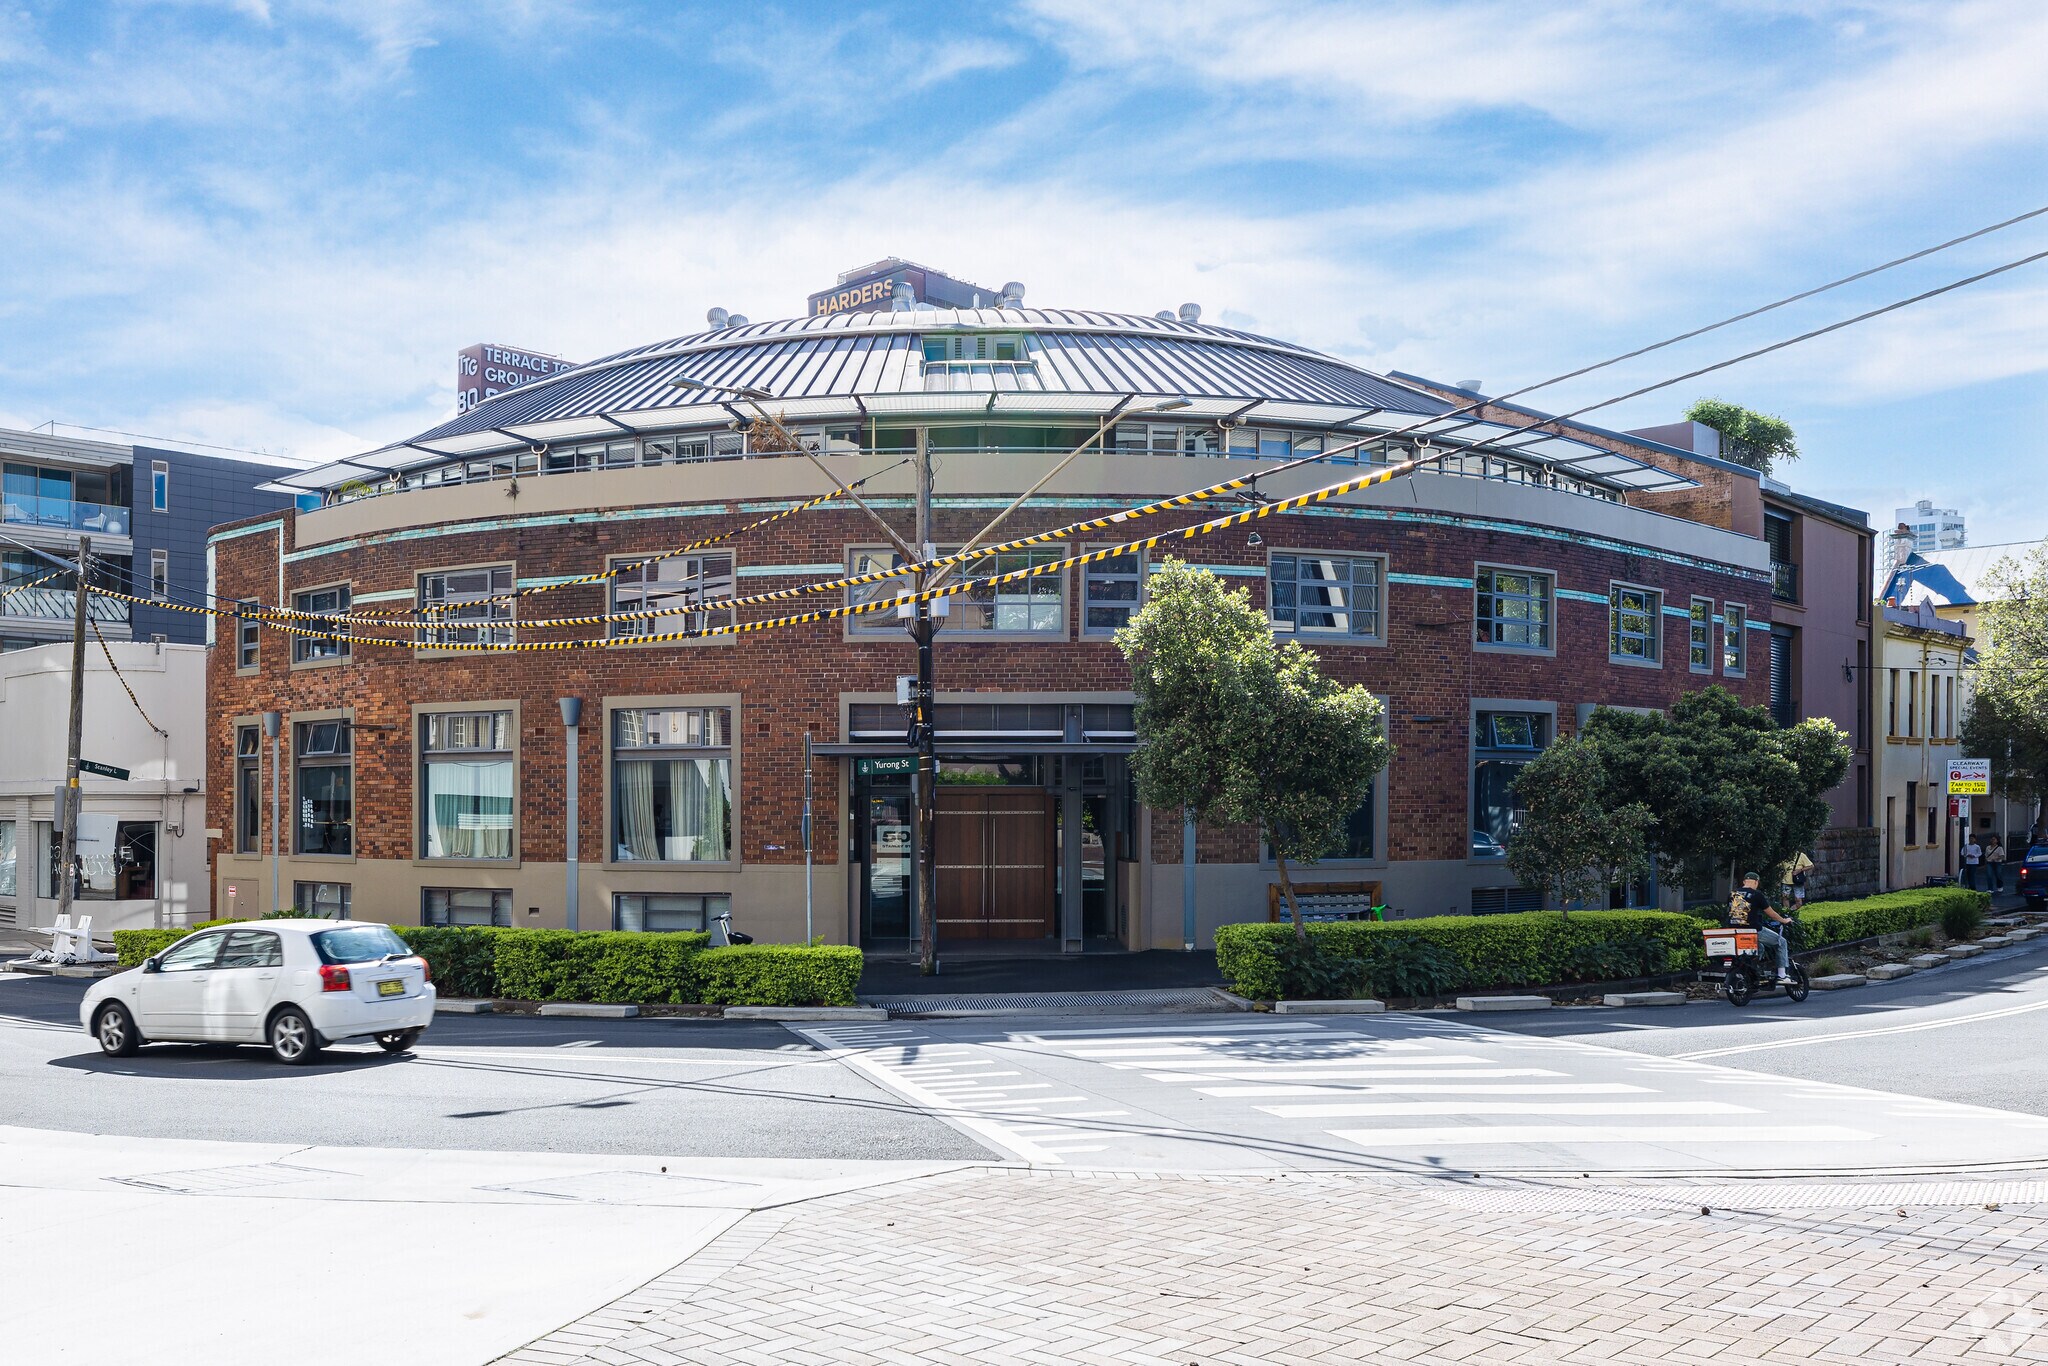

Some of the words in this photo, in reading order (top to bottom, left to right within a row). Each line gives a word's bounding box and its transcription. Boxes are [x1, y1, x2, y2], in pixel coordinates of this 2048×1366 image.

[816, 278, 893, 315] HARDERS
[458, 354, 478, 376] TTG
[484, 347, 549, 373] TERRACE
[94, 763, 113, 774] Stanley
[874, 760, 900, 770] Yurong
[901, 759, 910, 768] St
[882, 830, 911, 843] 50
